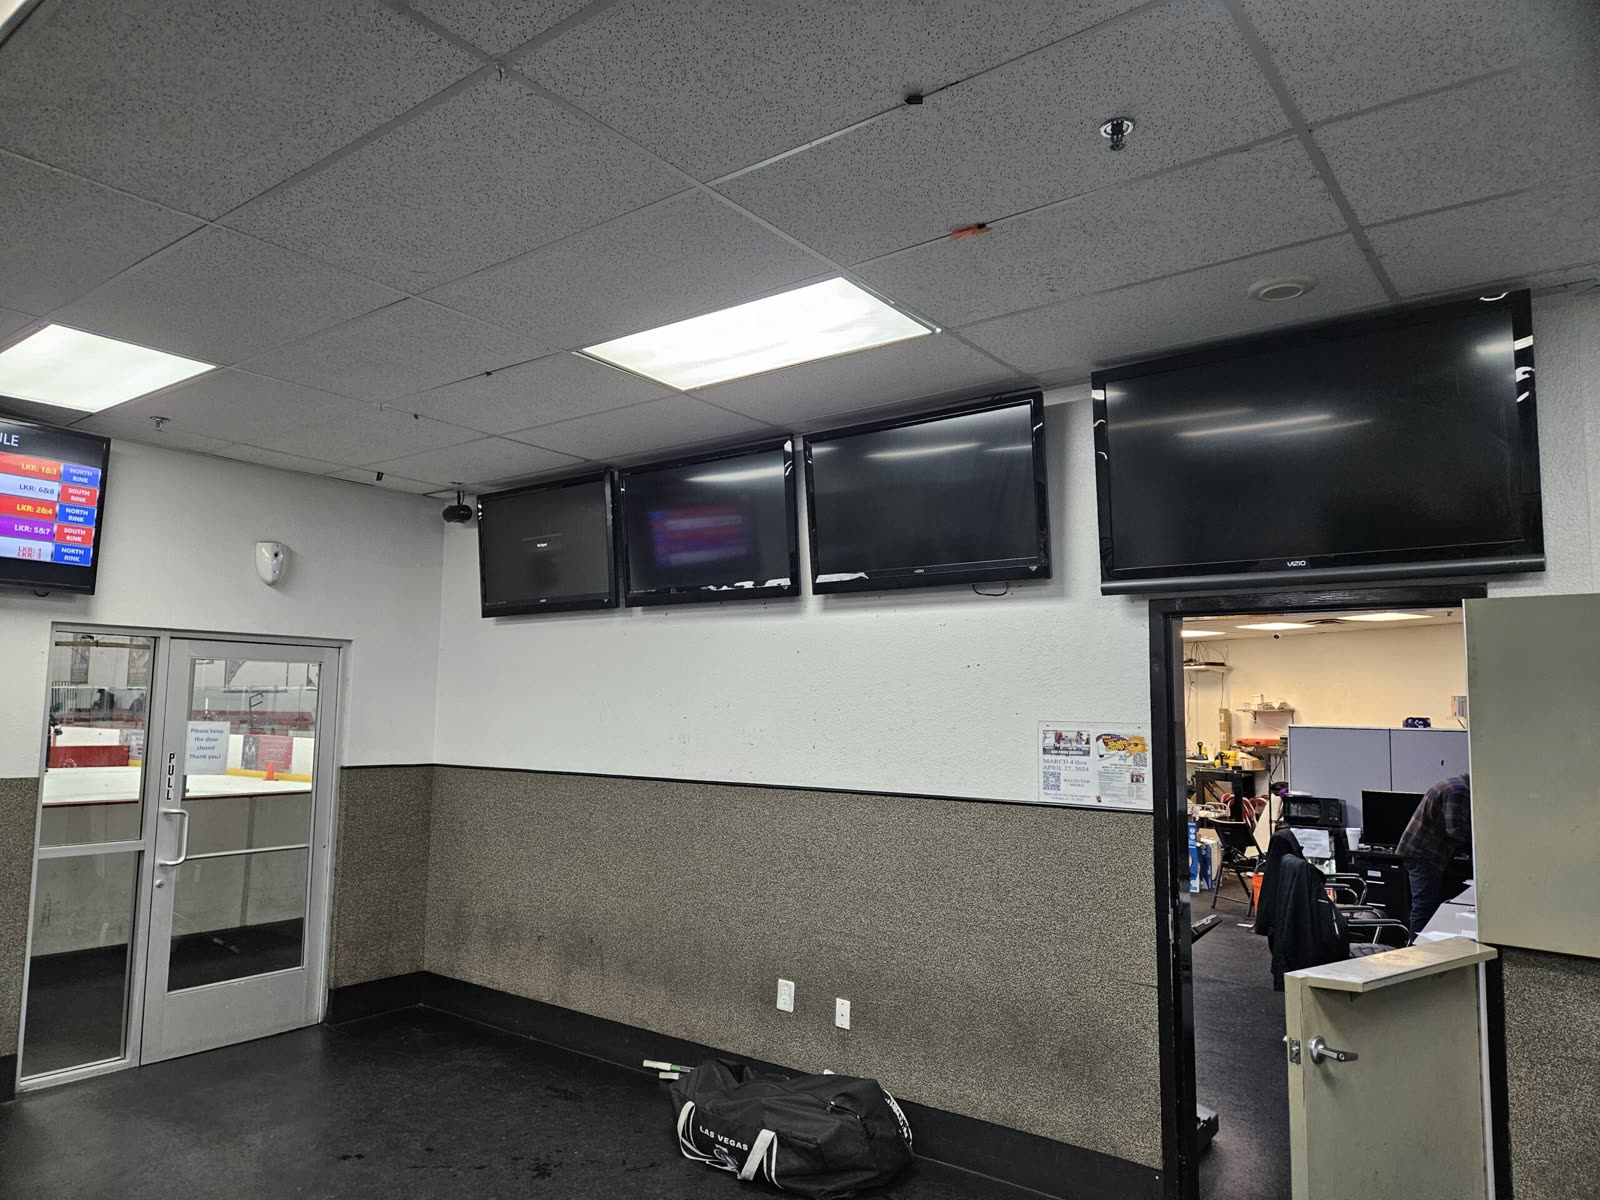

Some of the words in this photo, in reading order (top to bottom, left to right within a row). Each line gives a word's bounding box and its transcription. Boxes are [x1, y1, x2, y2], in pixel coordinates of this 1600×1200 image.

[21, 463, 39, 471] LKR:
[70, 468, 93, 477] NORTH
[72, 475, 89, 484] RINK
[19, 483, 37, 492] LKR:
[38, 487, 55, 495] 6&8
[68, 487, 90, 495] SOUTH
[70, 495, 86, 503] RINK
[16, 504, 34, 512] LKR:
[36, 507, 53, 515] 2&4
[65, 507, 89, 516] NORTH
[68, 515, 84, 523] RINK
[14, 524, 32, 533] LKR:
[33, 527, 51, 535] 5&7
[63, 527, 86, 535] SOUTH
[66, 535, 82, 543] RINK
[61, 547, 84, 556] NORTH
[166, 752, 176, 801] PULL
[699, 1125, 715, 1139] LAS
[717, 1134, 749, 1152] VEGAS
